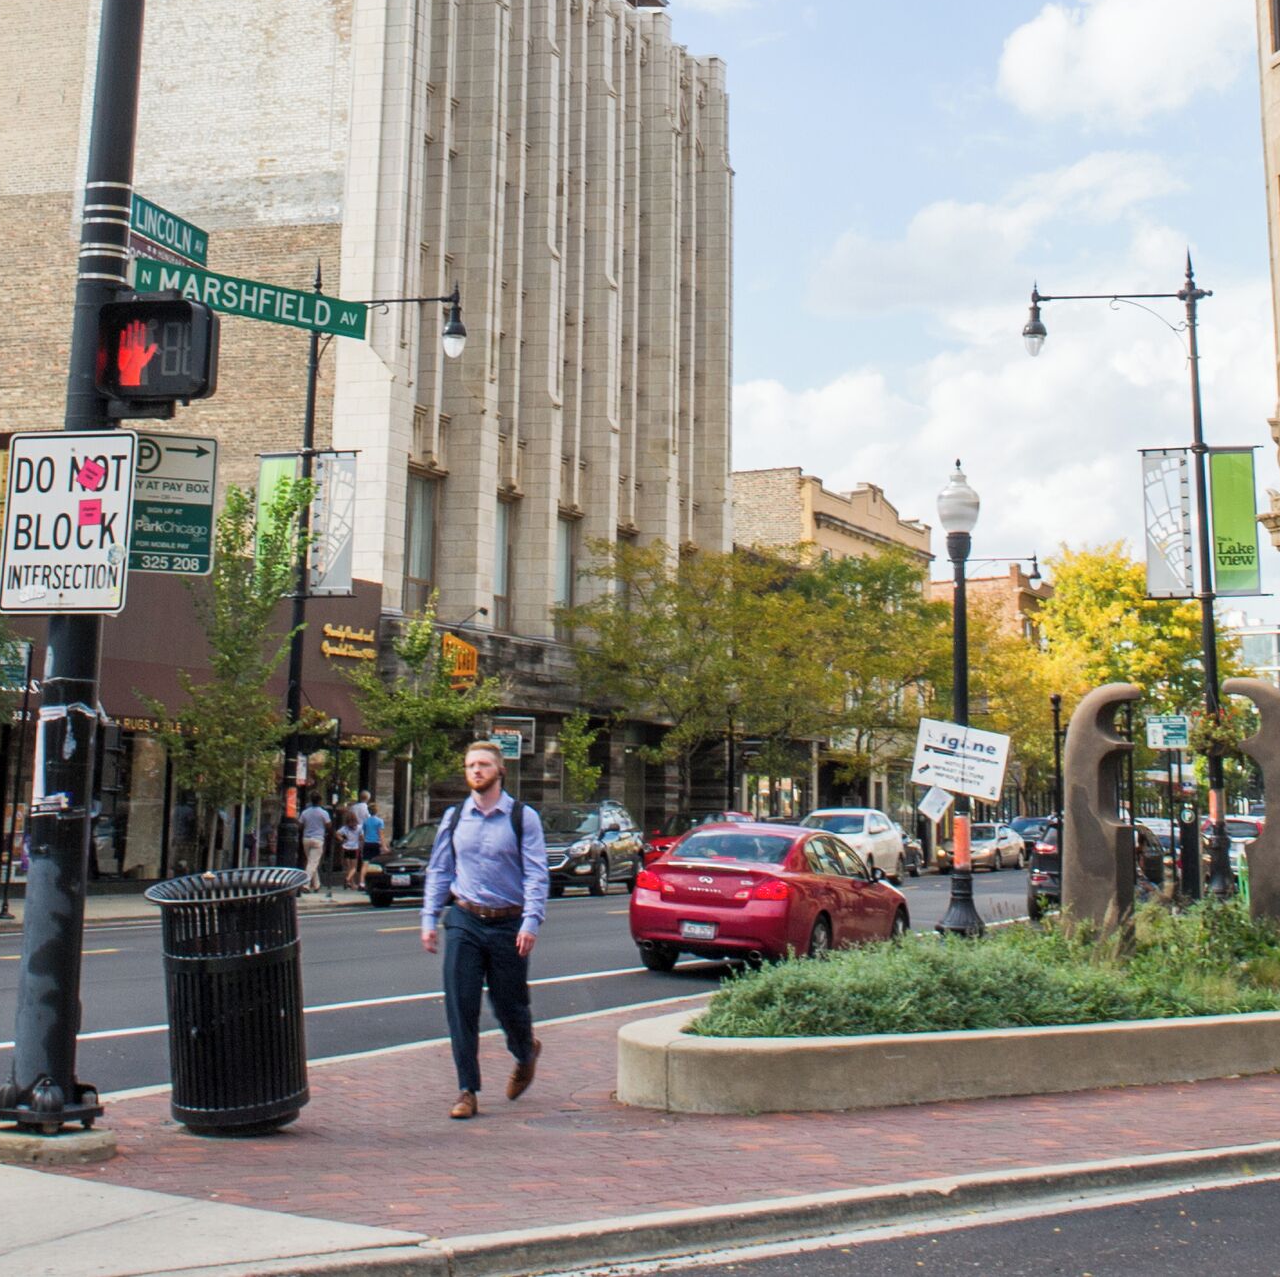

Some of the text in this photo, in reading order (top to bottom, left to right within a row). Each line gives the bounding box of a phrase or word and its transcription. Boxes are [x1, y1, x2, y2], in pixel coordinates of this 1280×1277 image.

[136, 201, 192, 255] LINCOLN
[194, 239, 204, 254] AV
[140, 267, 358, 327] N MARSHFIELD AV
[14, 454, 128, 494] DO NOT
[145, 480, 160, 491] AT
[162, 481, 184, 492] PAY
[185, 483, 210, 494] BOX
[13, 512, 119, 550] BLOCK
[135, 520, 208, 538] ParkChicago
[1218, 542, 1255, 555] Lake
[141, 555, 200, 570] 325 208
[1218, 555, 1256, 566] view
[7, 564, 119, 590] INTERSECTION
[123, 717, 151, 731] RUGS
